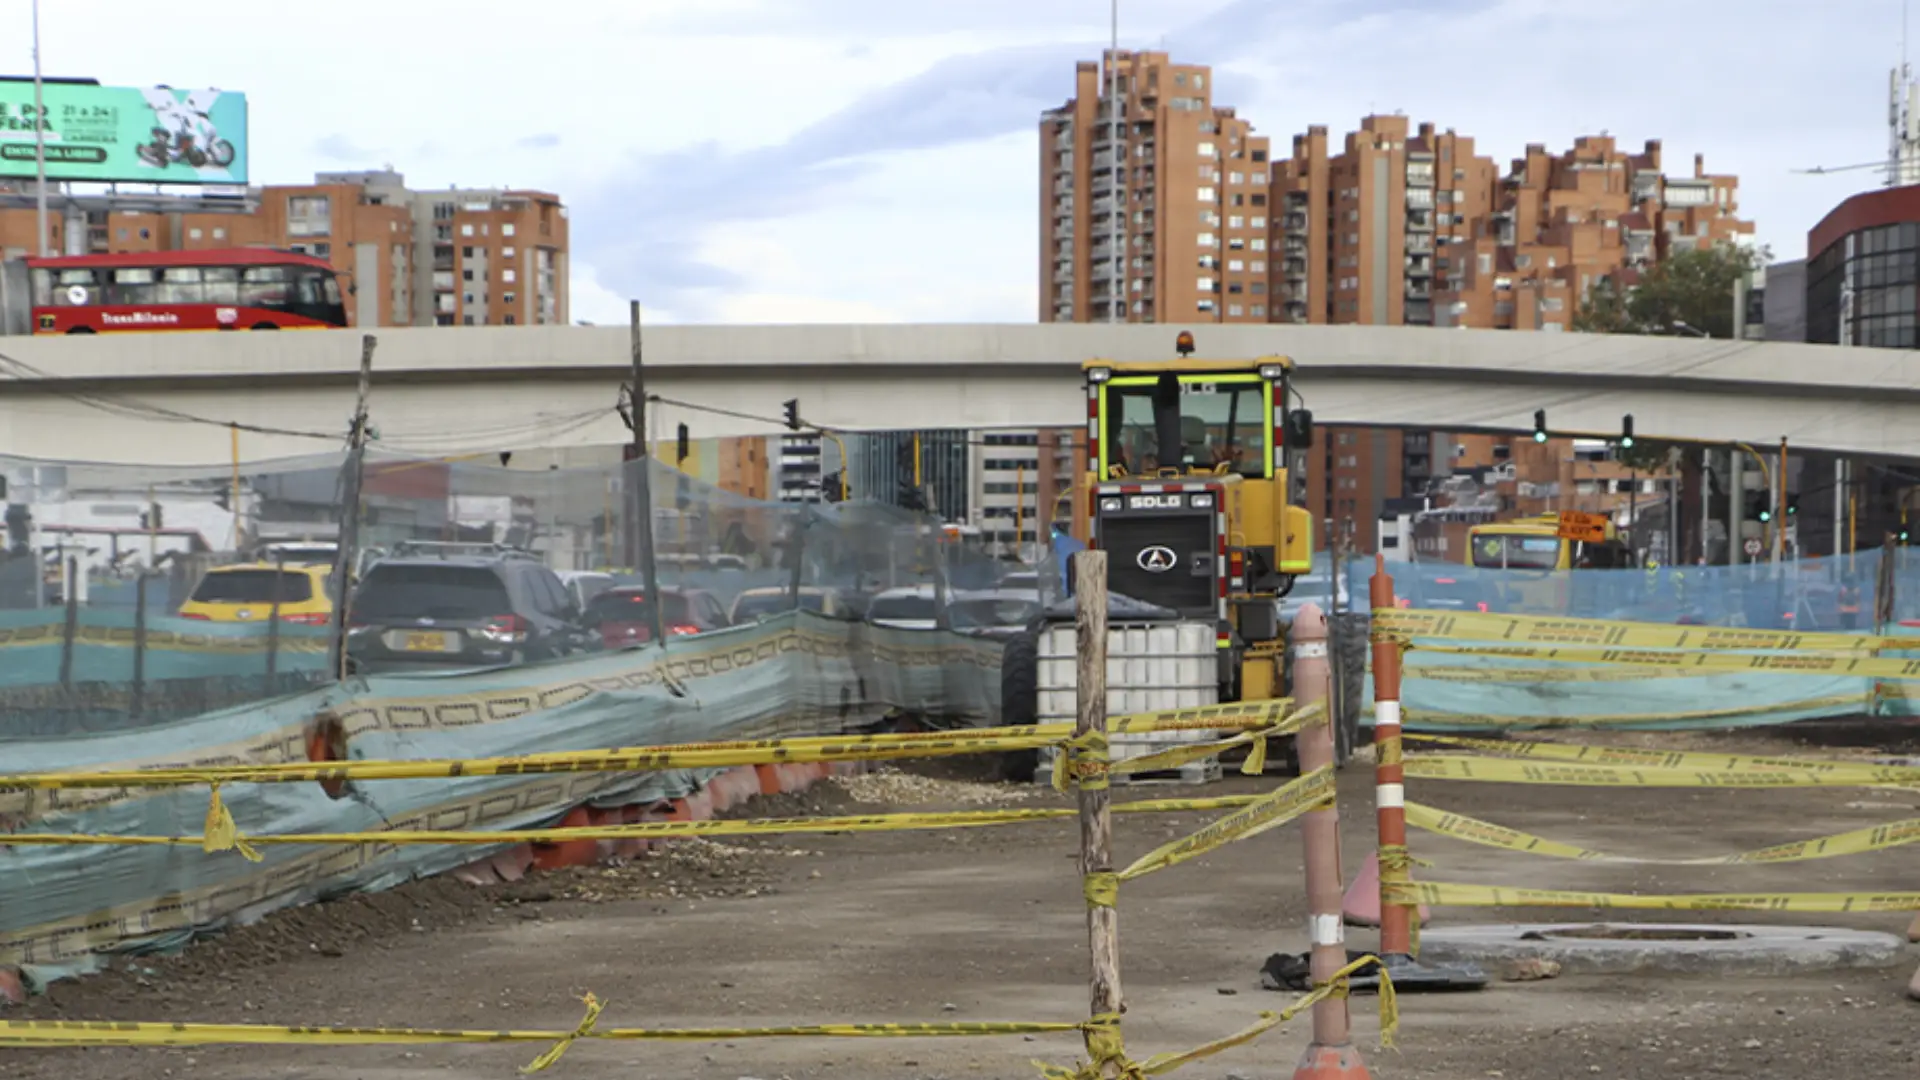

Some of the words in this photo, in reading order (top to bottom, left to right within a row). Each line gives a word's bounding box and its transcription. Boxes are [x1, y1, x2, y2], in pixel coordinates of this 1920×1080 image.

[62, 104, 76, 115] 21
[92, 105, 109, 116] 24
[101, 311, 178, 324] TransMilenio
[1130, 495, 1181, 509] SDLG
